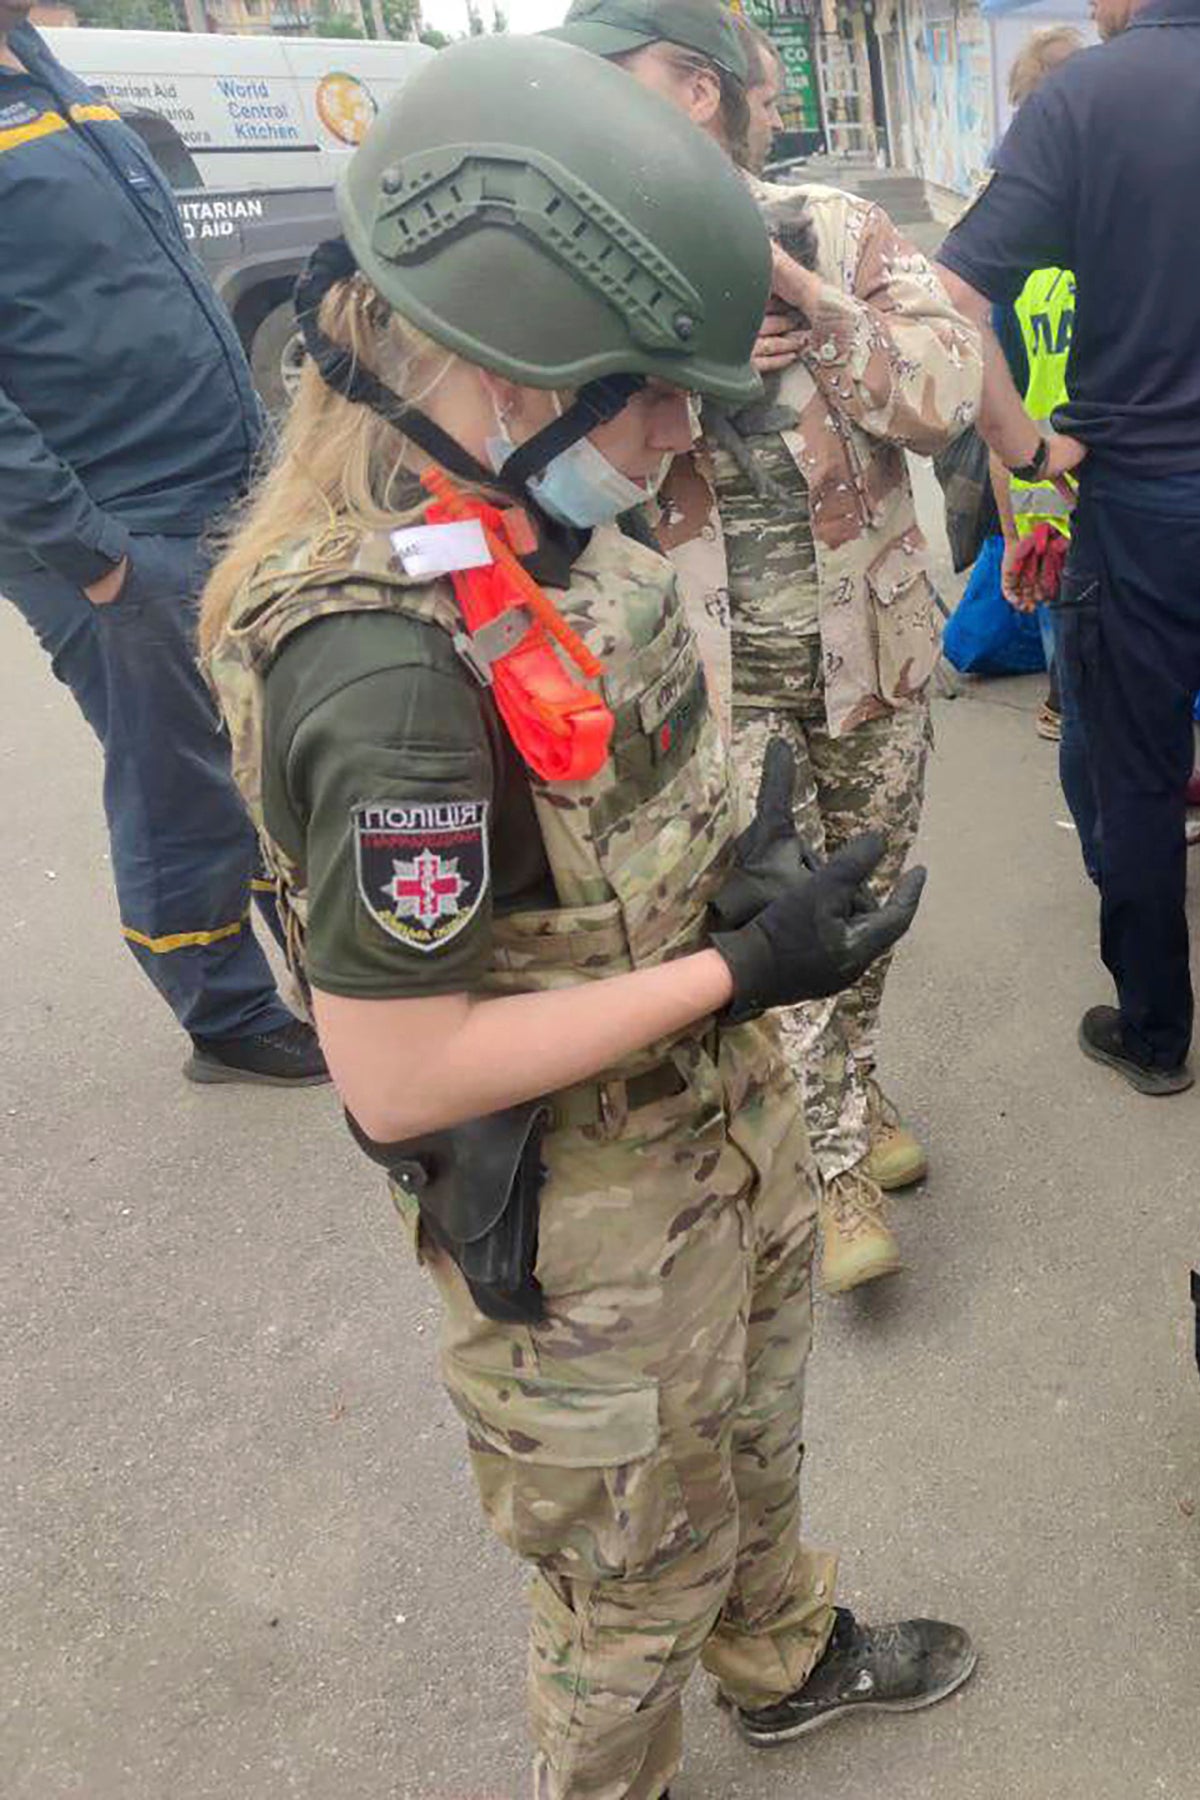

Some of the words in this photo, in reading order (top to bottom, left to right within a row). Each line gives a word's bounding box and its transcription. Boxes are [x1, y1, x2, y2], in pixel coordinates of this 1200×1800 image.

[154, 82, 178, 98] Aid
[216, 80, 270, 99] World
[228, 101, 289, 119] Central
[235, 122, 299, 140] Kitchen
[201, 221, 233, 238] AID
[365, 804, 477, 829] ПОЛІЦІЯ
